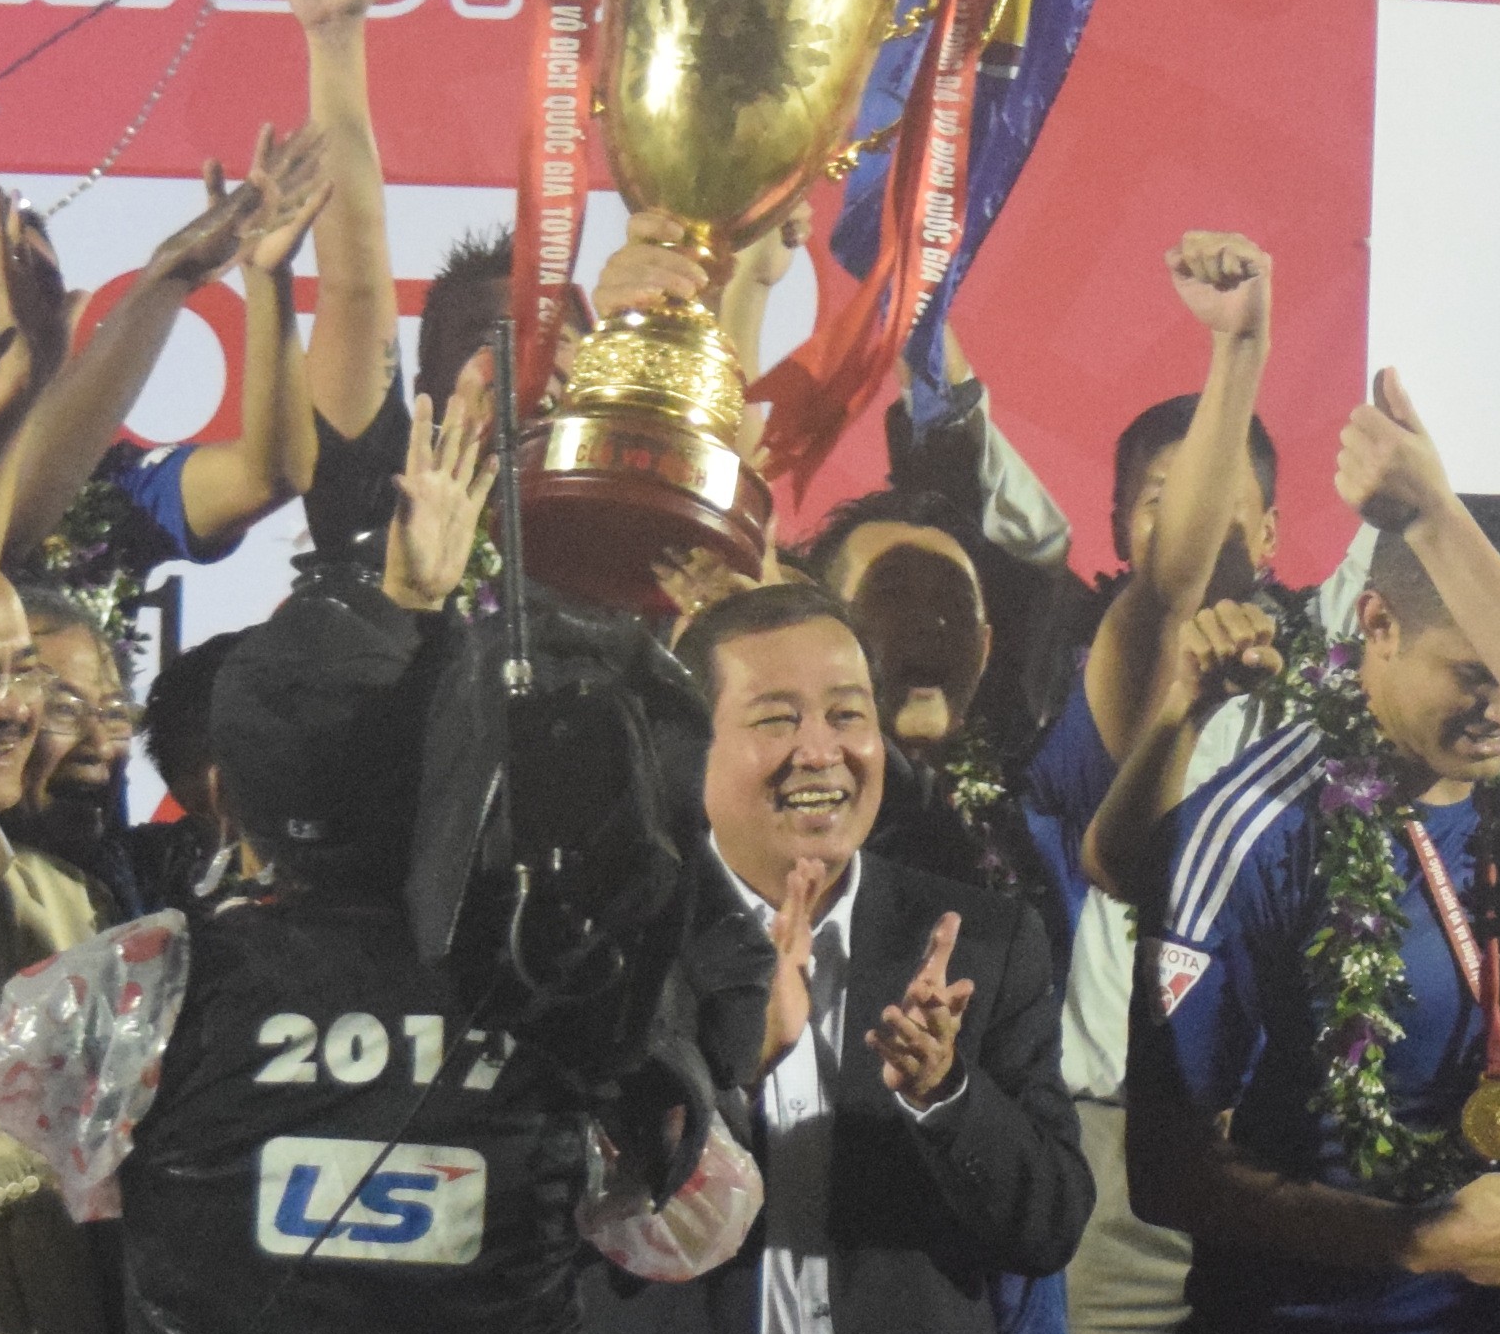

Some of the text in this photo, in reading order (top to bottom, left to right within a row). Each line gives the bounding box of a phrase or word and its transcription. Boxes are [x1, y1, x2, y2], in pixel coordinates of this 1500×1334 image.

[542, 37, 581, 89] ĐỊCH
[542, 95, 586, 155] QUỐC
[542, 161, 576, 197] GIA
[539, 207, 573, 285] TOYOTA
[920, 246, 951, 284] GIA
[272, 1164, 442, 1244] LS
